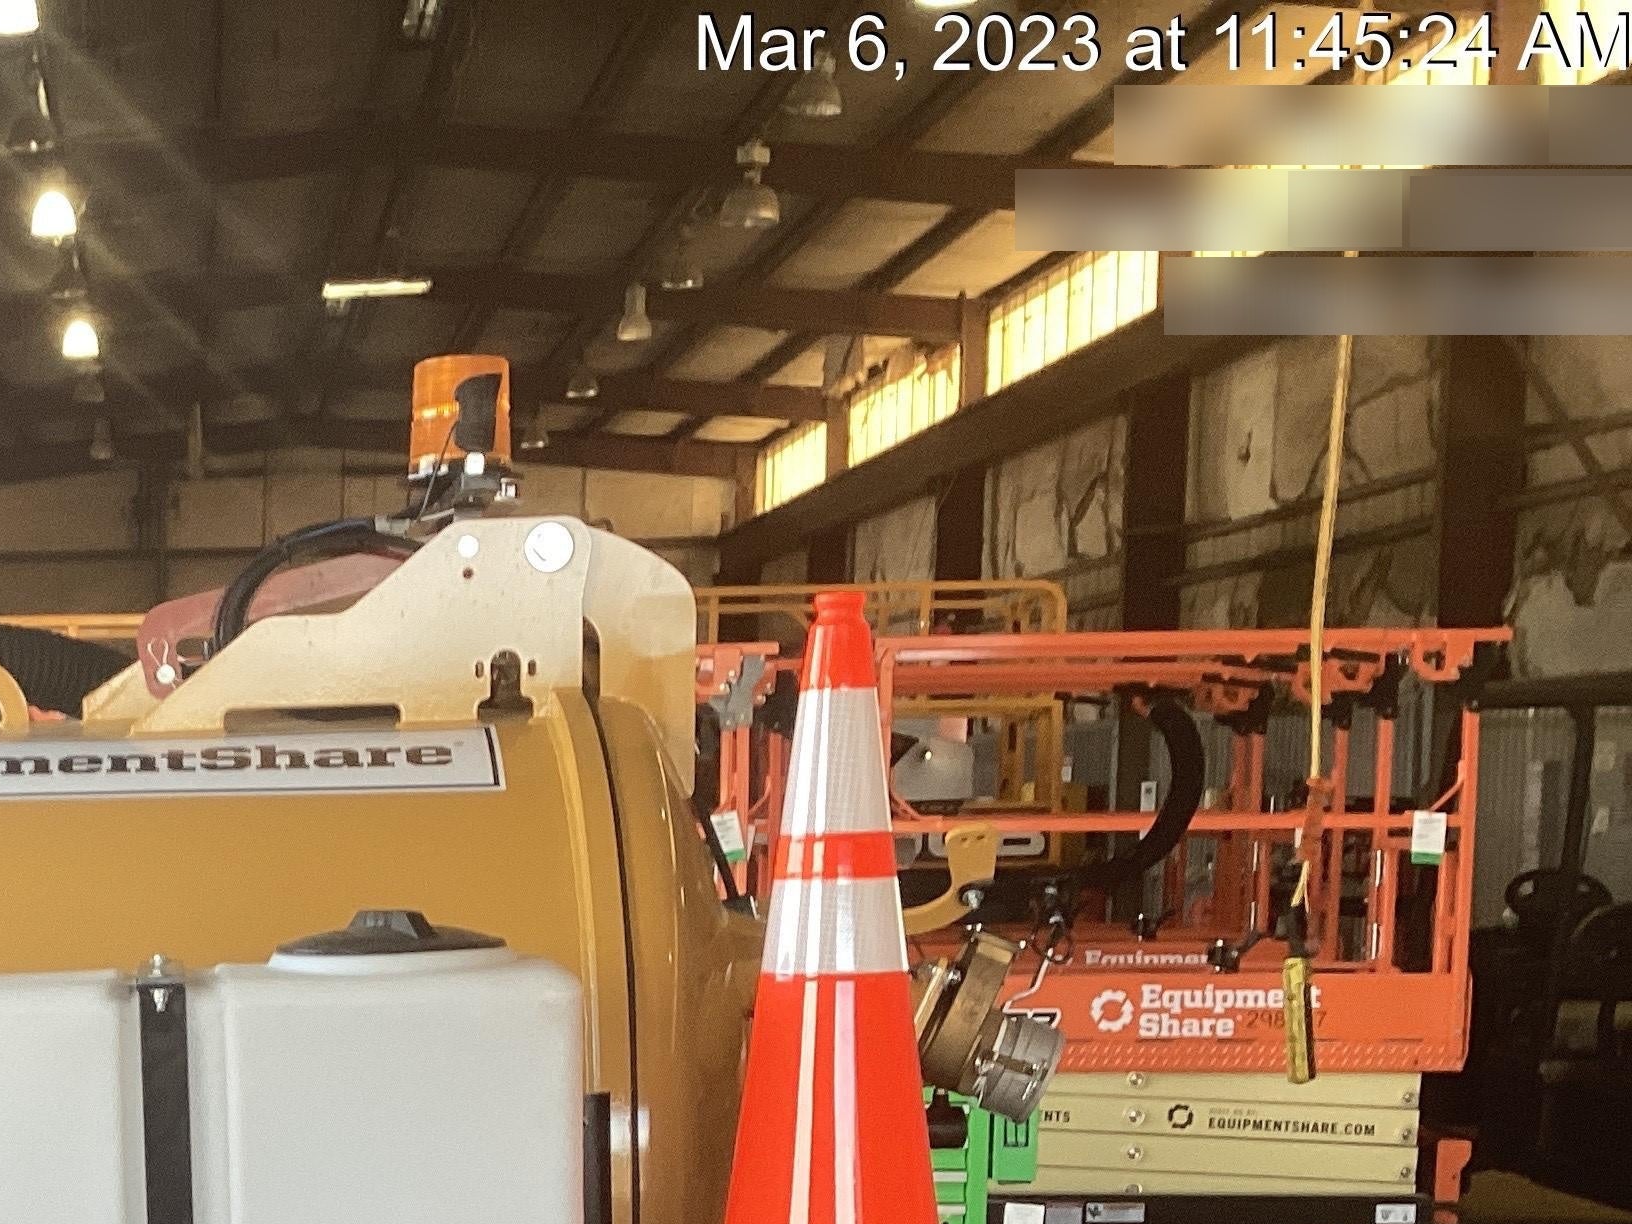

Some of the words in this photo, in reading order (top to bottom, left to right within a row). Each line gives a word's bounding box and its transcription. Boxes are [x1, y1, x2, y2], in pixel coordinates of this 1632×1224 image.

[1140, 983, 1321, 1013] Equipmet
[1138, 1013, 1235, 1038] Share
[1041, 1110, 1071, 1123] NTS
[1208, 1116, 1375, 1137] EQUIPMENTSHARE.COM
